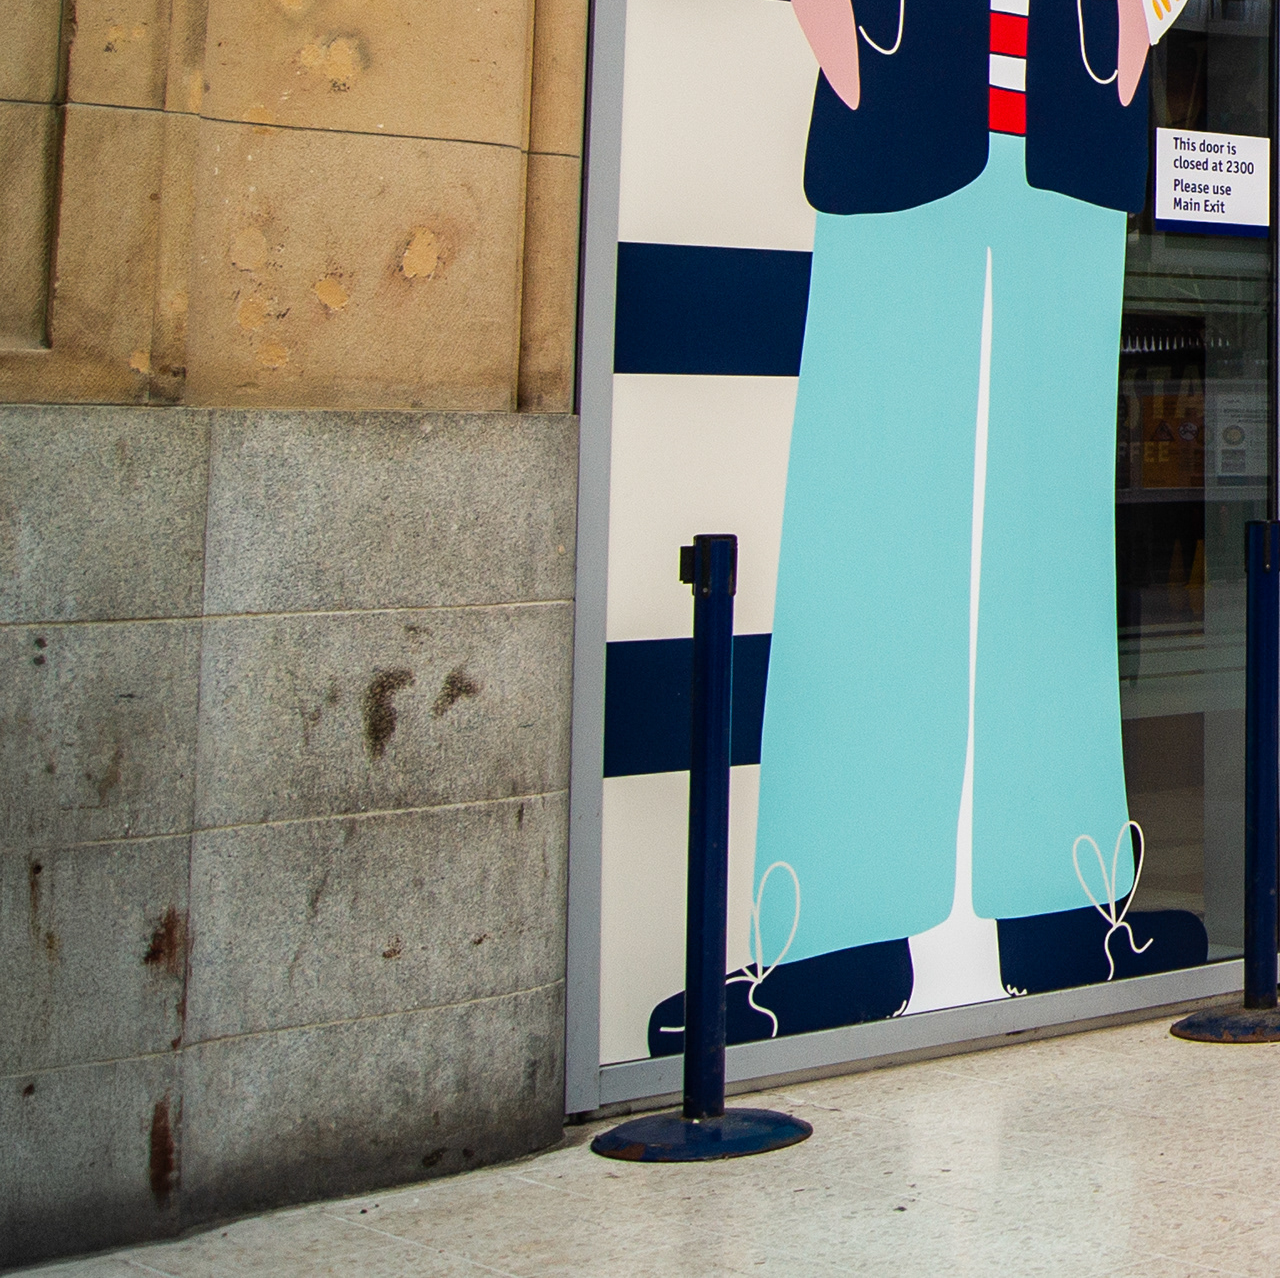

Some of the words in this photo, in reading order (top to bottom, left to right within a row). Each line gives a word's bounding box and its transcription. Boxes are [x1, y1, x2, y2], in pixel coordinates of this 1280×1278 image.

[1173, 137, 1196, 151] This
[1199, 139, 1224, 154] door
[1227, 142, 1237, 155] is
[1173, 155, 1209, 171] closed
[1211, 160, 1223, 172] at
[1226, 160, 1254, 175] 2300
[1173, 178, 1209, 194] Please
[1212, 184, 1232, 195] use
[1173, 197, 1200, 211] Main
[1204, 199, 1225, 213] Exit
